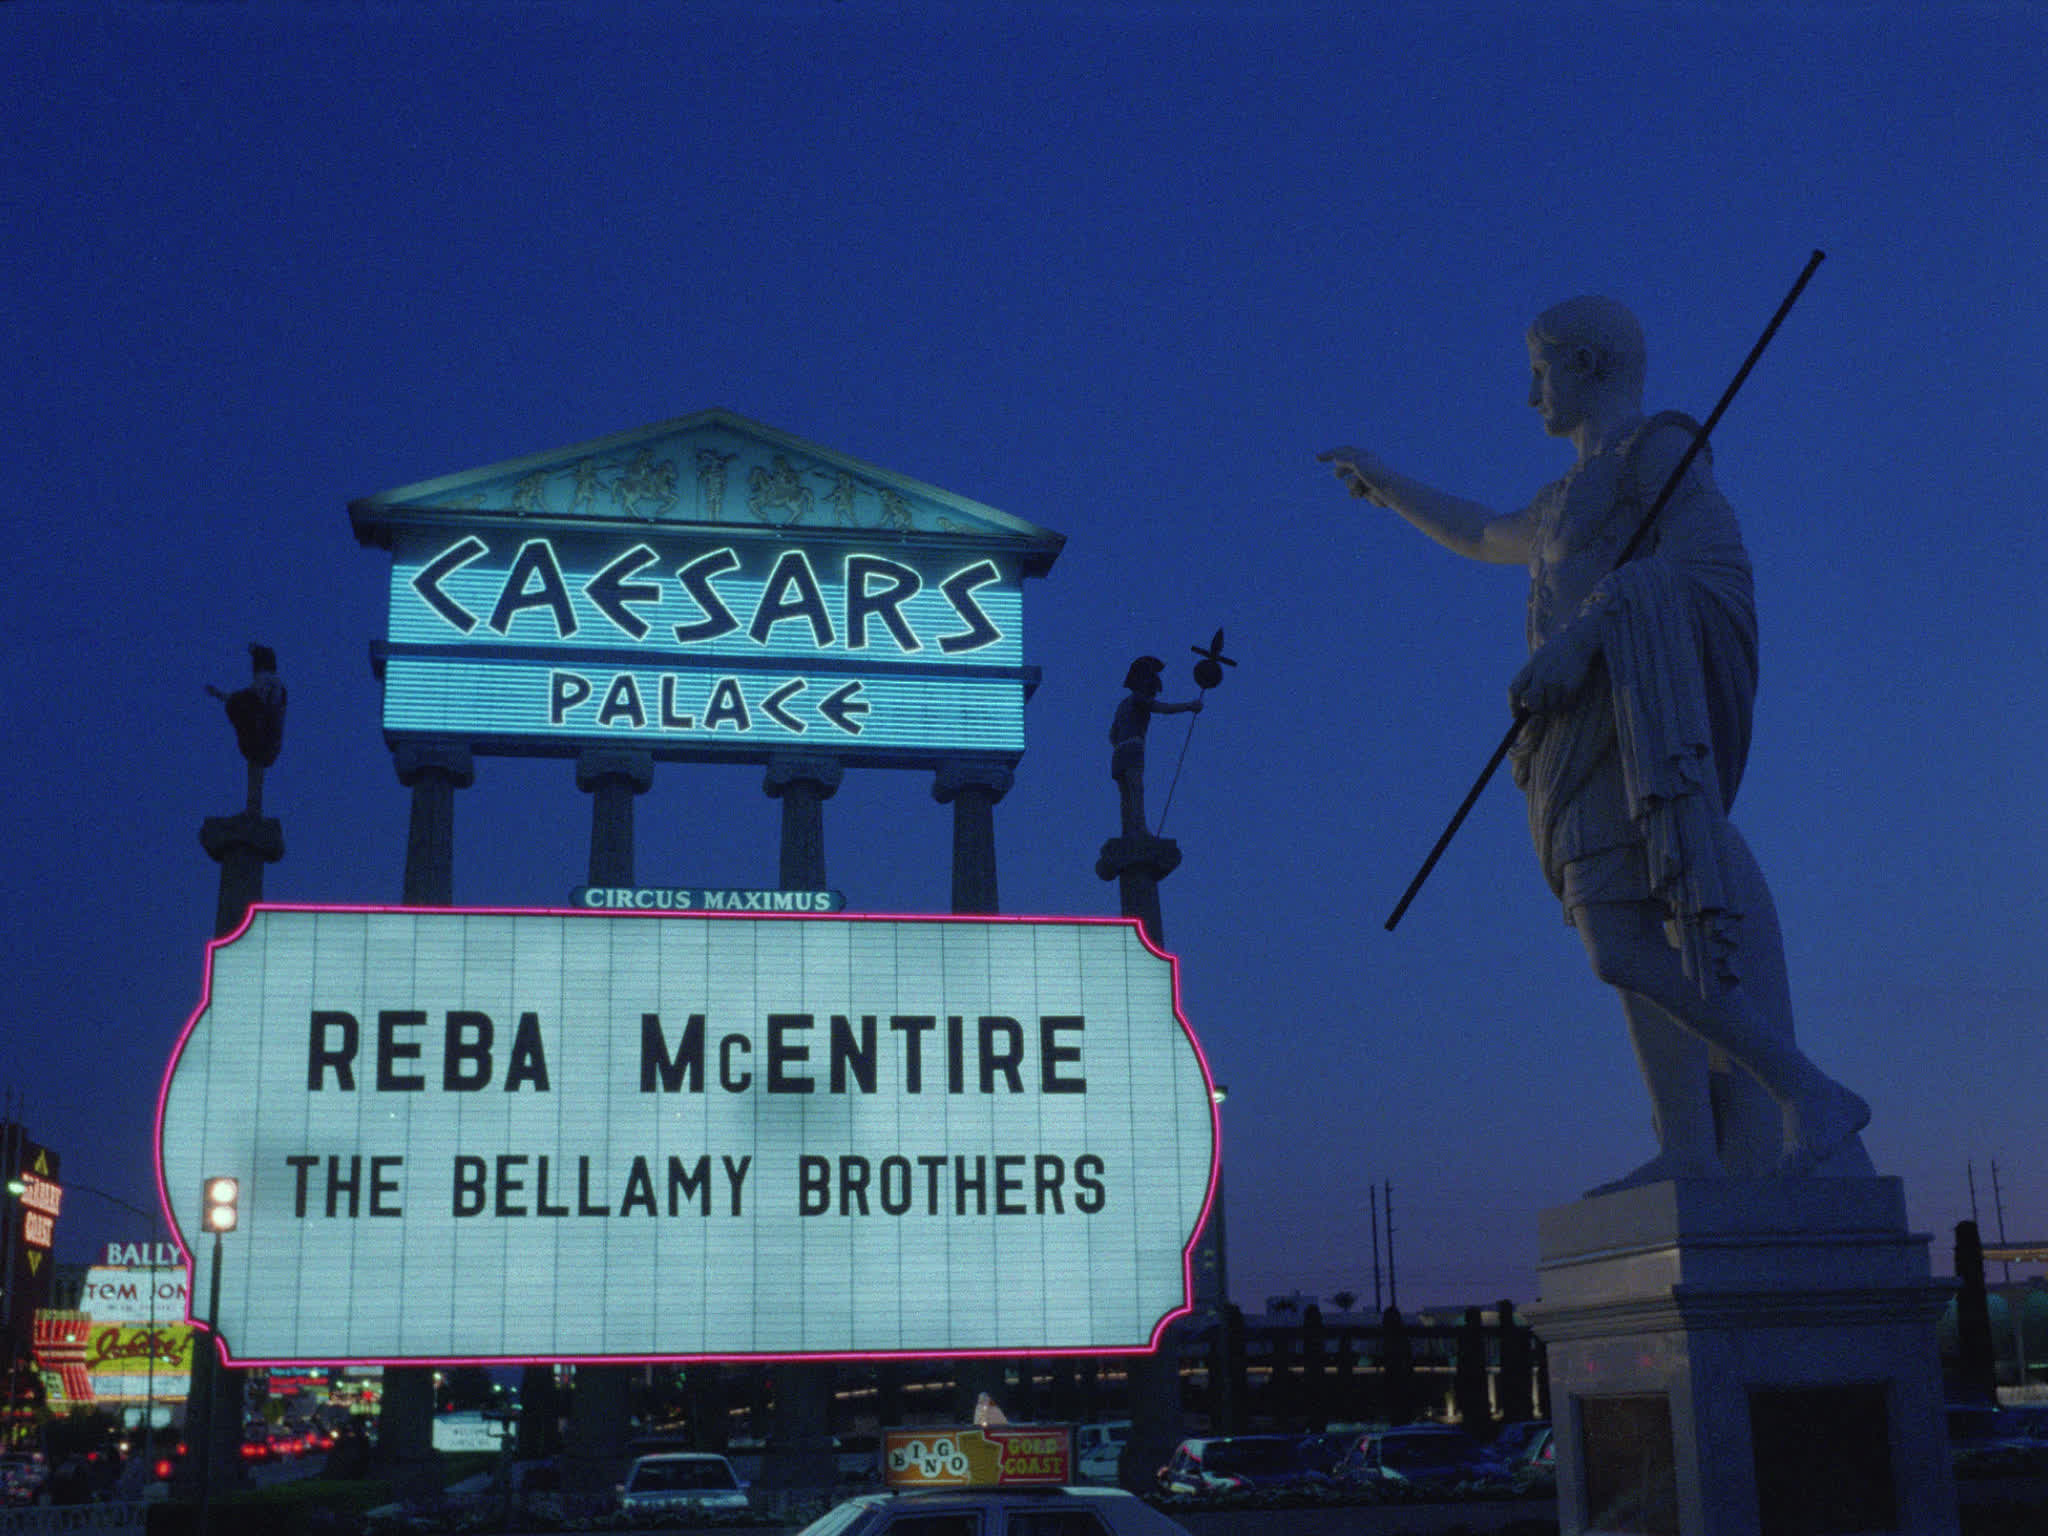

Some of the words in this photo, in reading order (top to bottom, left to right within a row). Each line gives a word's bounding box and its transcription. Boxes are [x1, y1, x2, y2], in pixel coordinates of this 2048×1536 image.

[410, 535, 1004, 655] CAESARS
[548, 668, 872, 736] PALACE
[584, 888, 691, 909] CIRCUS
[703, 891, 831, 911] MAXIMUS
[308, 1010, 550, 1092] REBA
[286, 1155, 402, 1218] THE
[453, 1155, 752, 1218] BELLAMY
[799, 1154, 1106, 1216] BROTHERS
[87, 1283, 138, 1301] TOM
[1005, 1457, 1063, 1475] COAST
